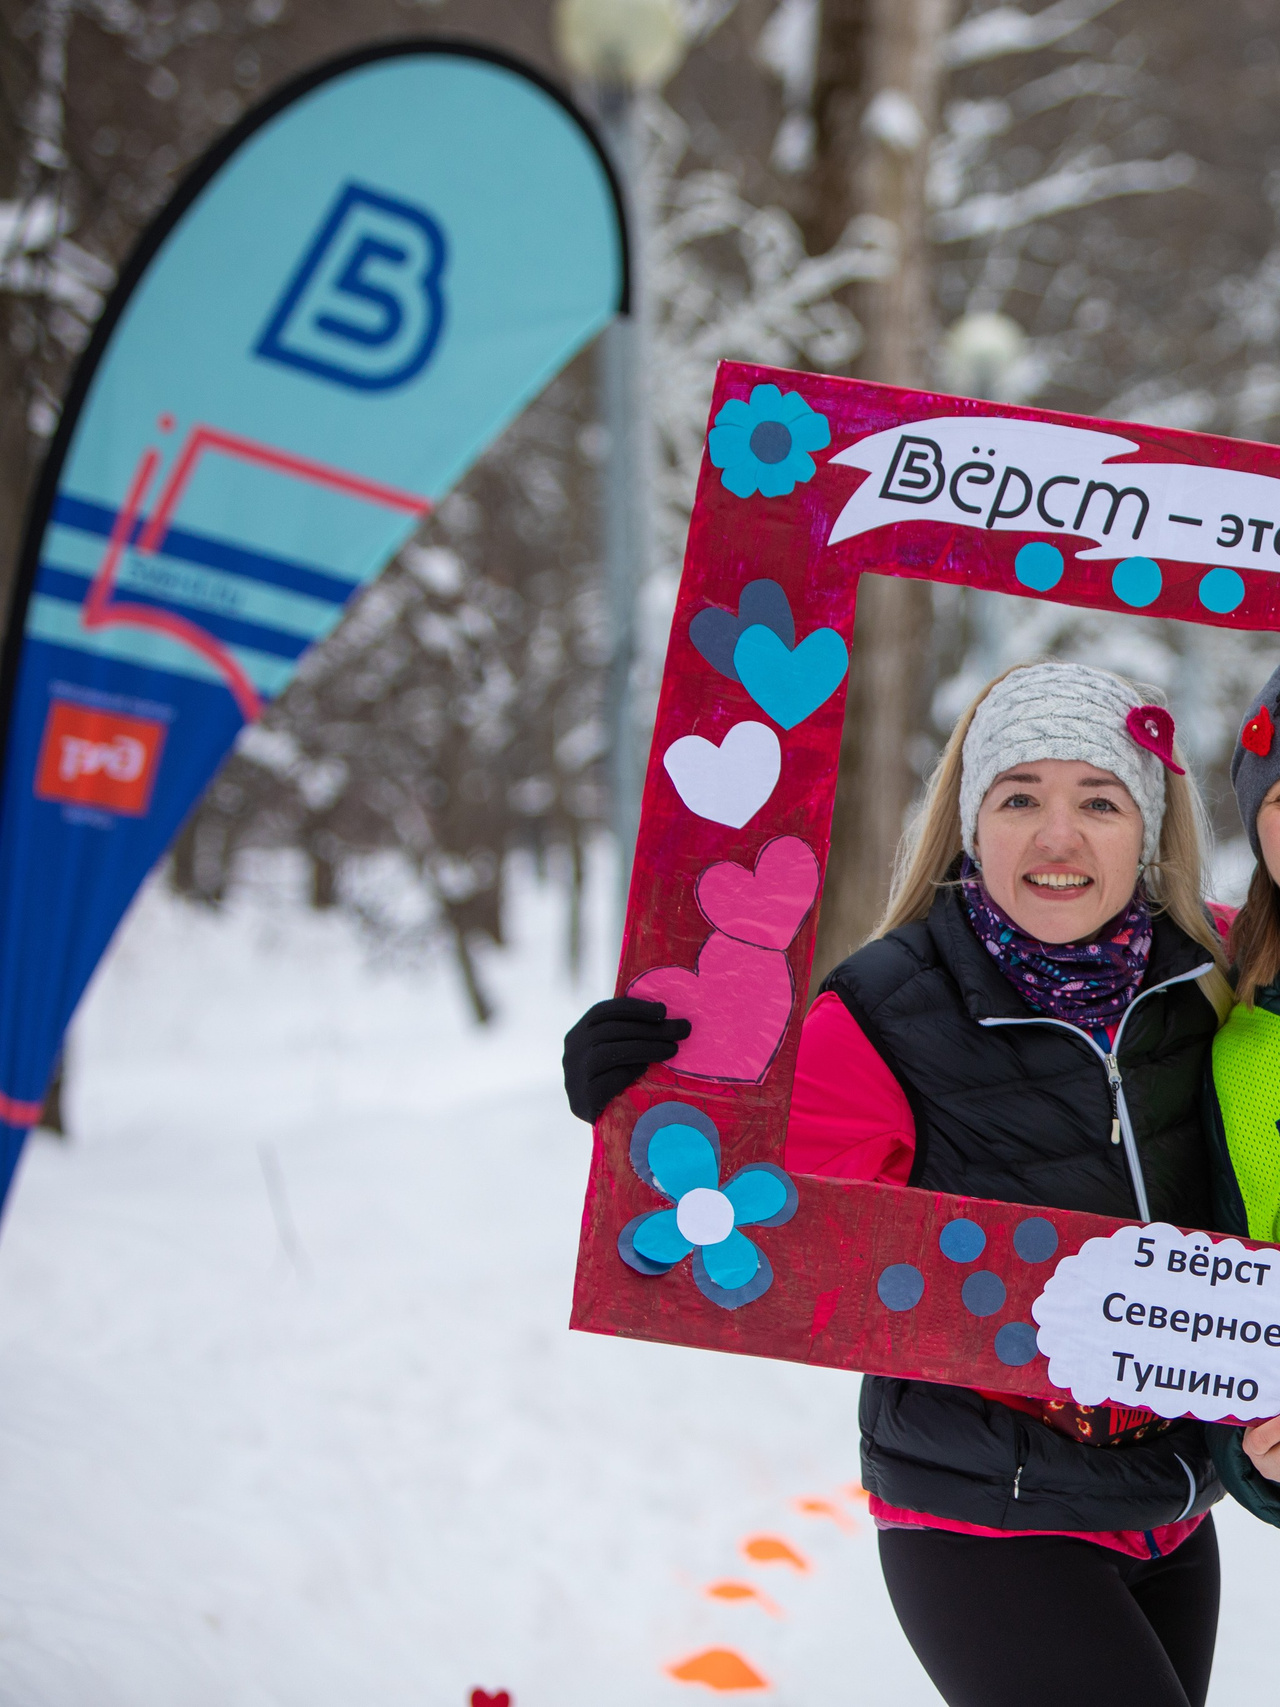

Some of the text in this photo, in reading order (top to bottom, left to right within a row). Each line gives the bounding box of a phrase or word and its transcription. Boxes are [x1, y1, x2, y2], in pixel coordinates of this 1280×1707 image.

[1133, 1237, 1272, 1287] 5 вёрст
[1112, 1350, 1260, 1402] Тушино
